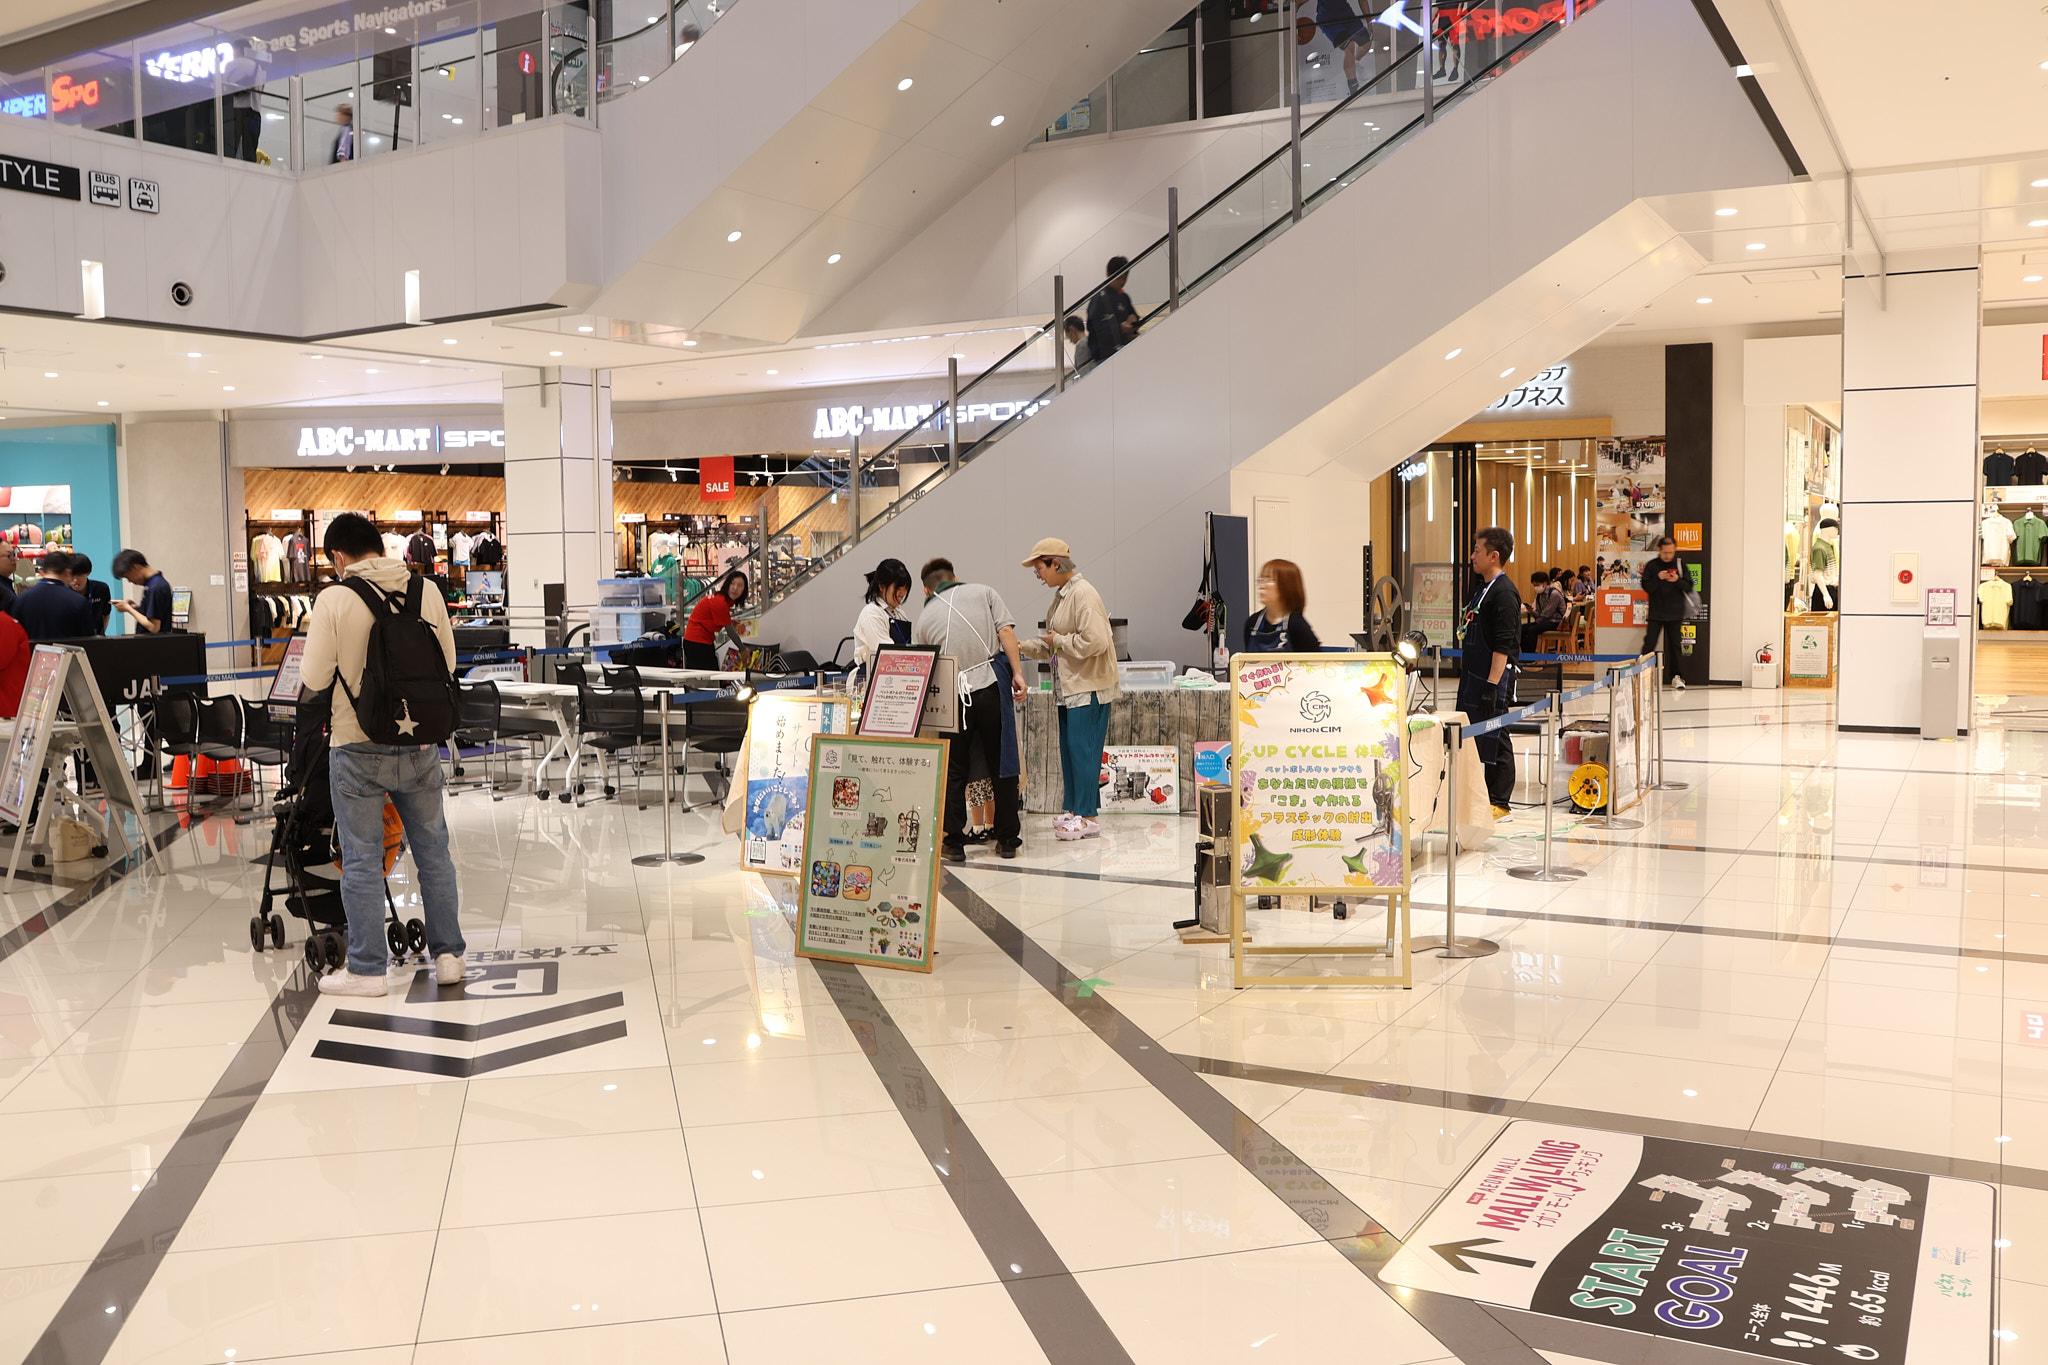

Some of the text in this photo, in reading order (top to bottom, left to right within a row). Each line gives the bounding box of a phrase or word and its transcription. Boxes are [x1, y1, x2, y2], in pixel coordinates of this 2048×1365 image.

[270, 34, 296, 50] are
[299, 19, 350, 46] Sports
[353, 0, 448, 32] Navigators!
[0, 159, 60, 192] TYLE
[94, 174, 116, 185] BUS
[132, 180, 156, 192] TAXI
[812, 403, 934, 438] ABC-MART
[297, 426, 431, 456] ABC-MART
[706, 482, 730, 493] SALE
[1422, 620, 1446, 630] 1980
[1253, 745, 1278, 758] UP
[1285, 745, 1347, 758] CYCLE
[1265, 765, 1363, 773] ペットボトルキャップから
[1258, 778, 1368, 790] あなただけの模様で
[1292, 829, 1342, 842] 成形体験
[1477, 1158, 1521, 1193] AEON MALL
[1661, 1221, 1685, 1232] 3F
[1570, 1228, 1669, 1316] START
[1654, 1245, 1748, 1330] GOAL
[1933, 1274, 1955, 1297] ハピネス
[1744, 1303, 1771, 1342] コース全体
